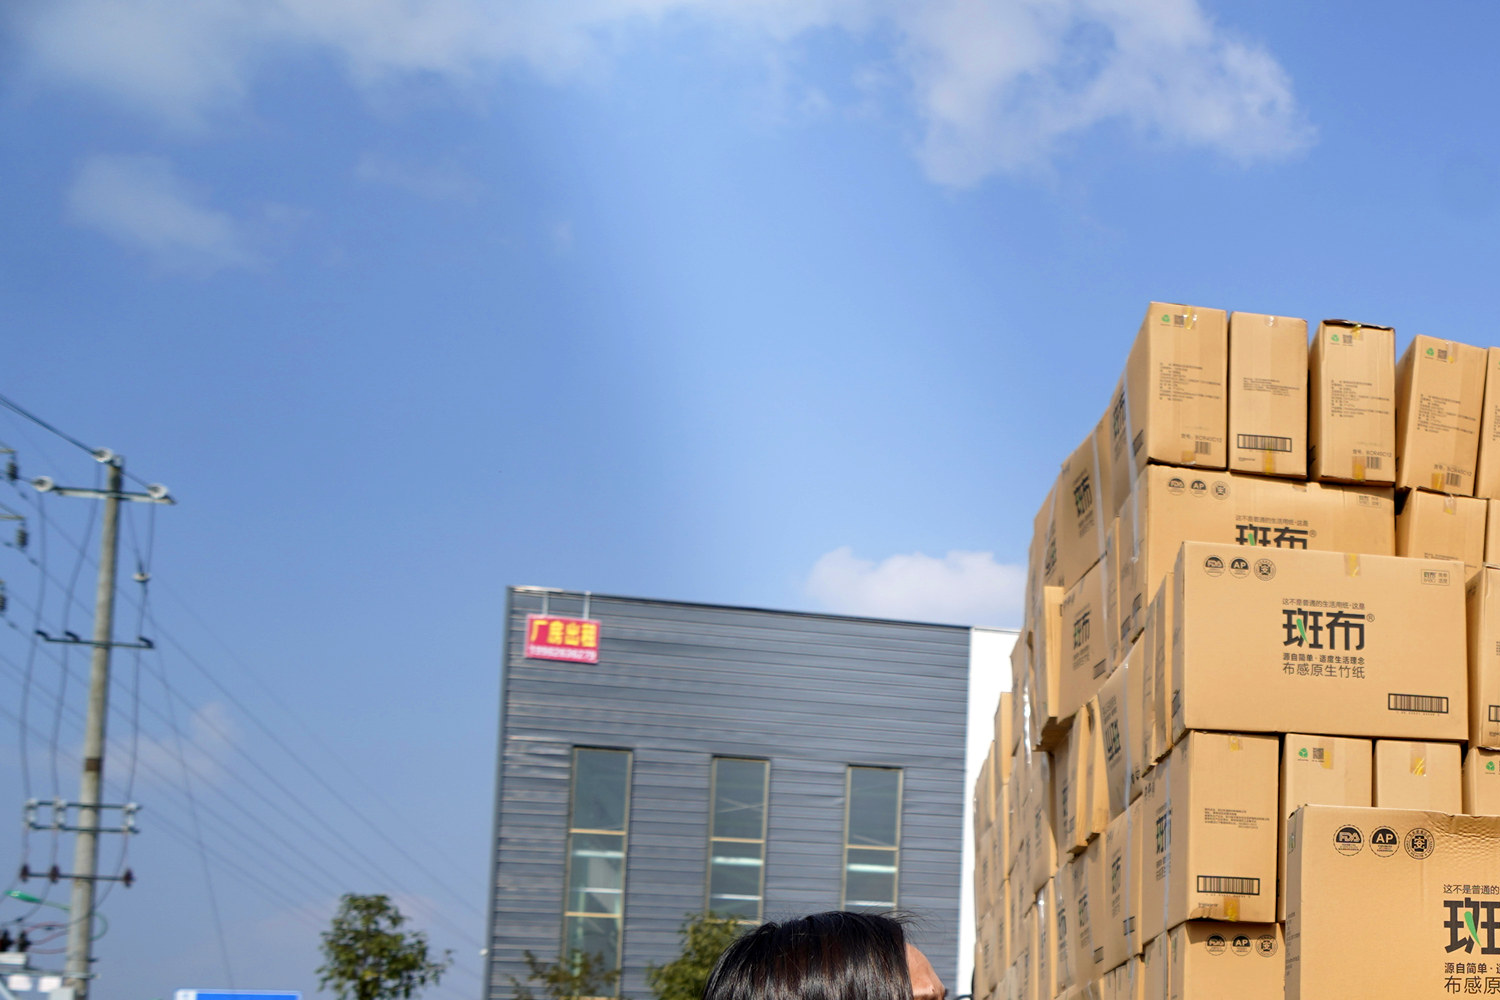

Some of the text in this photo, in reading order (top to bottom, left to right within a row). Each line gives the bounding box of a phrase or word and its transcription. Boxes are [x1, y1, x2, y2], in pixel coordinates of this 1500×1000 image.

[1282, 608, 1365, 651] 斑布
[1282, 663, 1365, 680] 布感原生竹纸
[1338, 832, 1362, 844] FDA
[1375, 833, 1394, 845] AP
